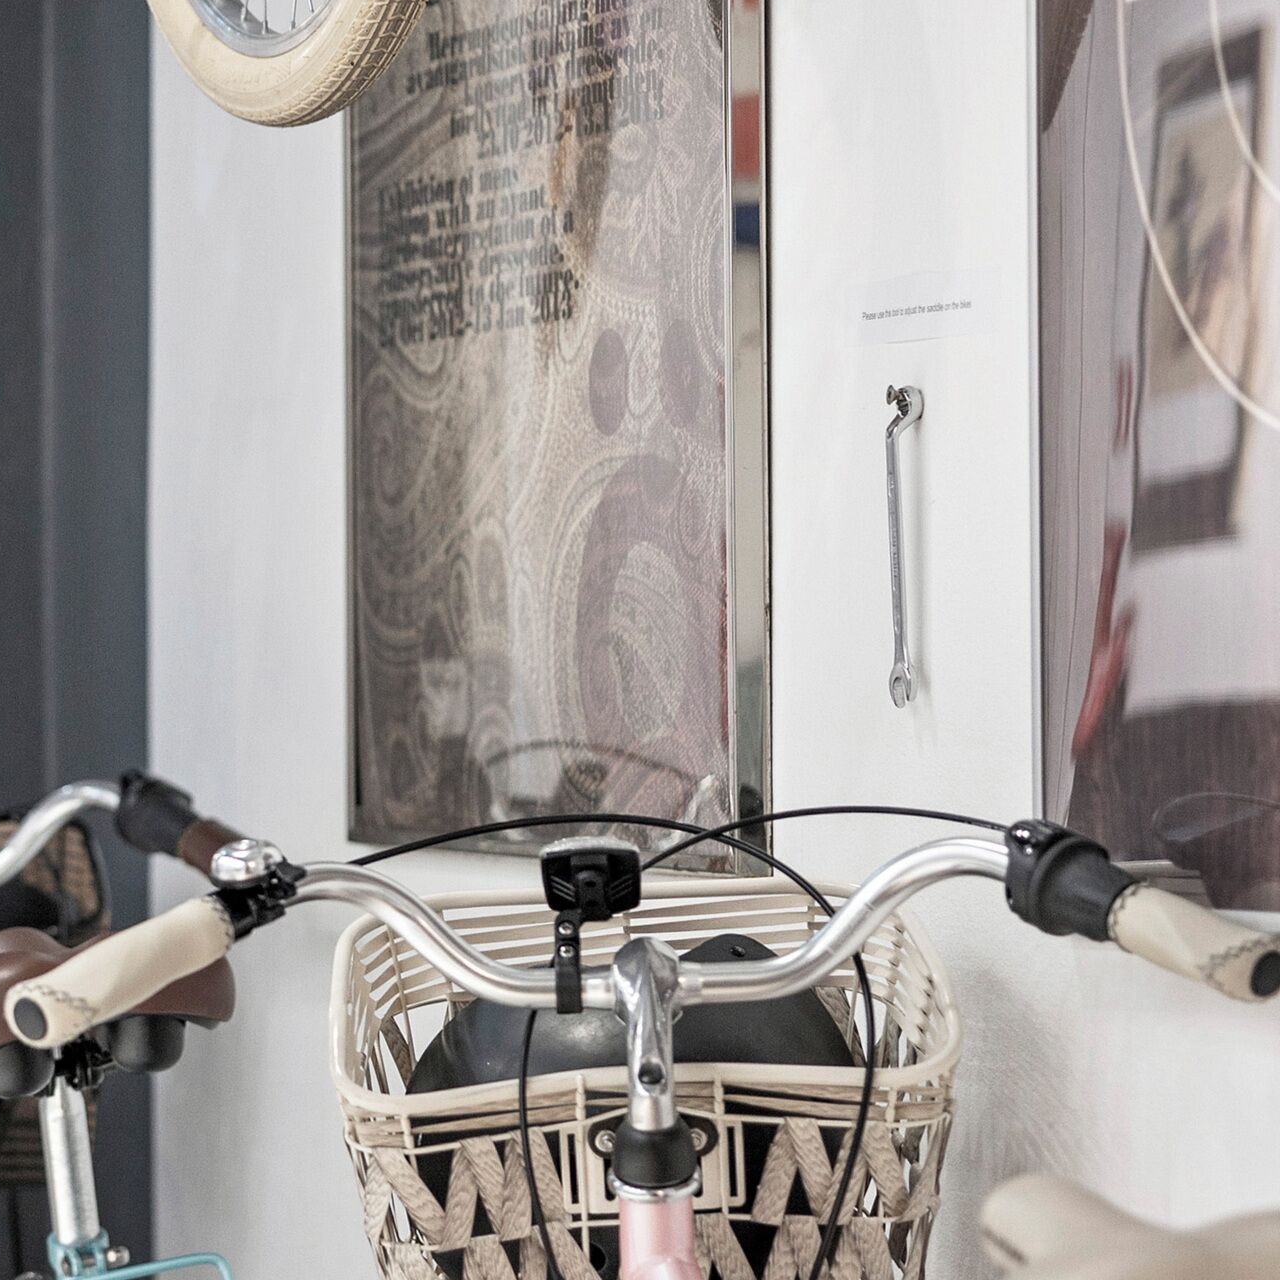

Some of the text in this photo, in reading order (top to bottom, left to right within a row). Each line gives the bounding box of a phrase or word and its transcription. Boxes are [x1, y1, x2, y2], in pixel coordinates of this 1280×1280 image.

[541, 205, 557, 234] of
[563, 210, 574, 233] a
[927, 302, 944, 313] saddle
